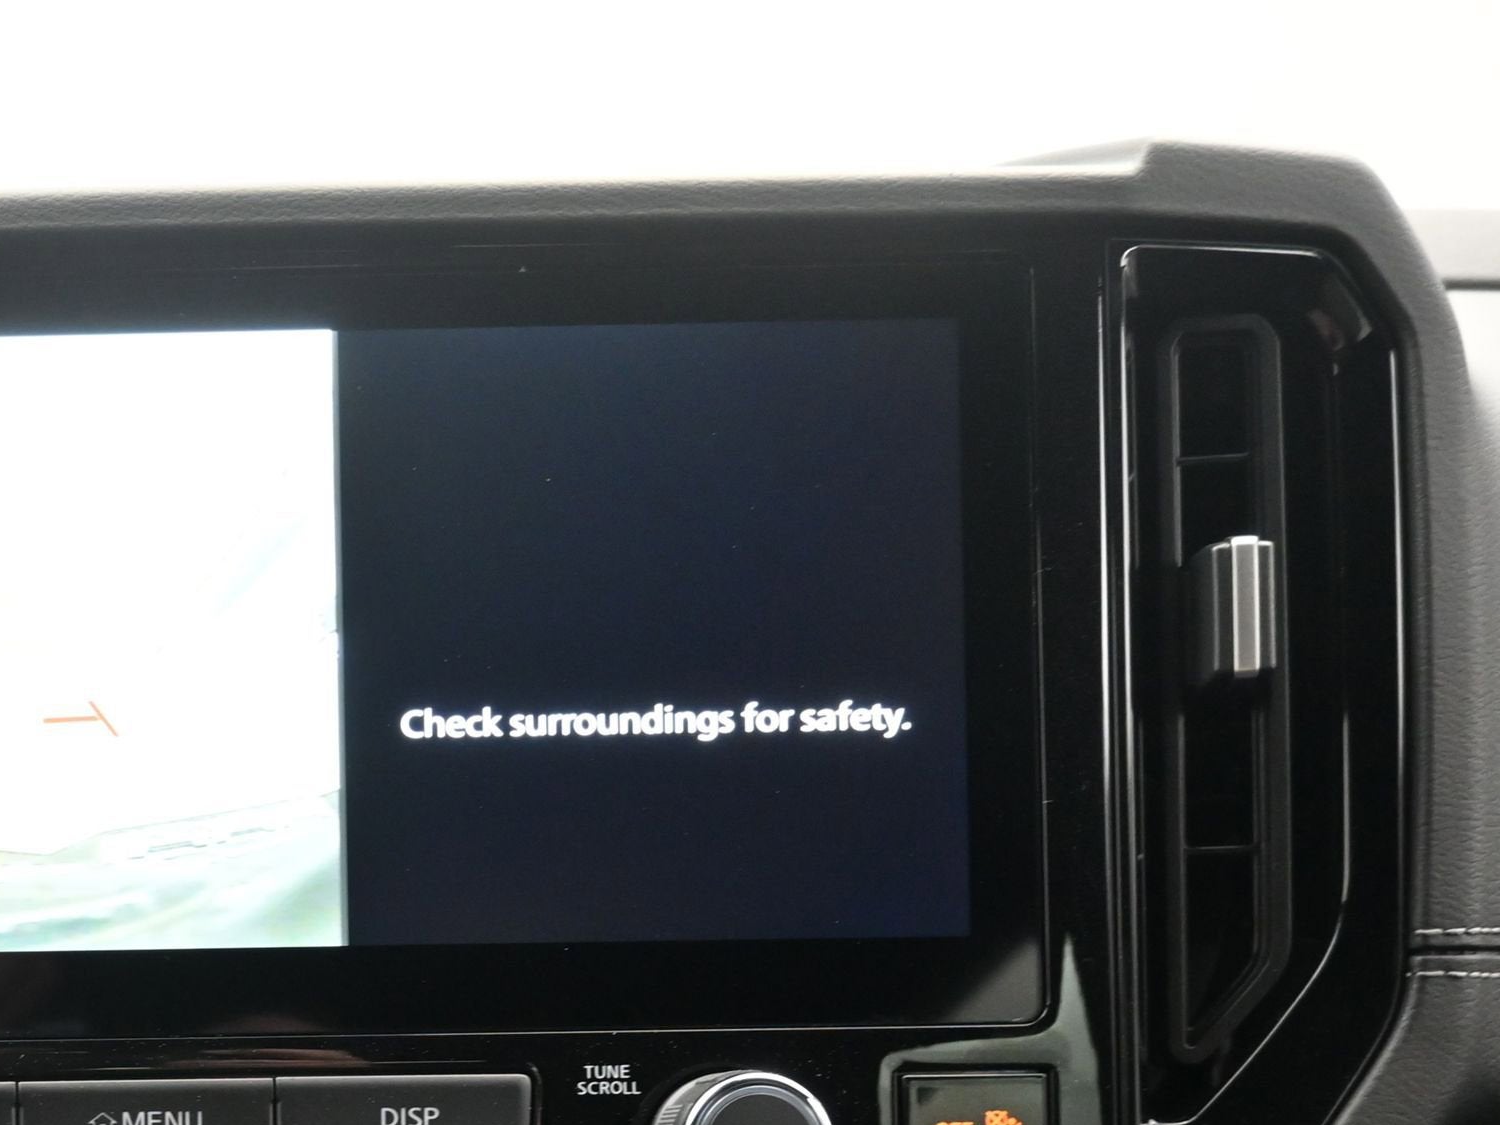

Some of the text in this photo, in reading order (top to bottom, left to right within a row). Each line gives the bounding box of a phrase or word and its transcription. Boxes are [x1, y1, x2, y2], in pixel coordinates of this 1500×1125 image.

[400, 699, 912, 742] Check surroundings for safety.
[584, 1065, 630, 1080] TUNE
[577, 1081, 641, 1096] SCROLL
